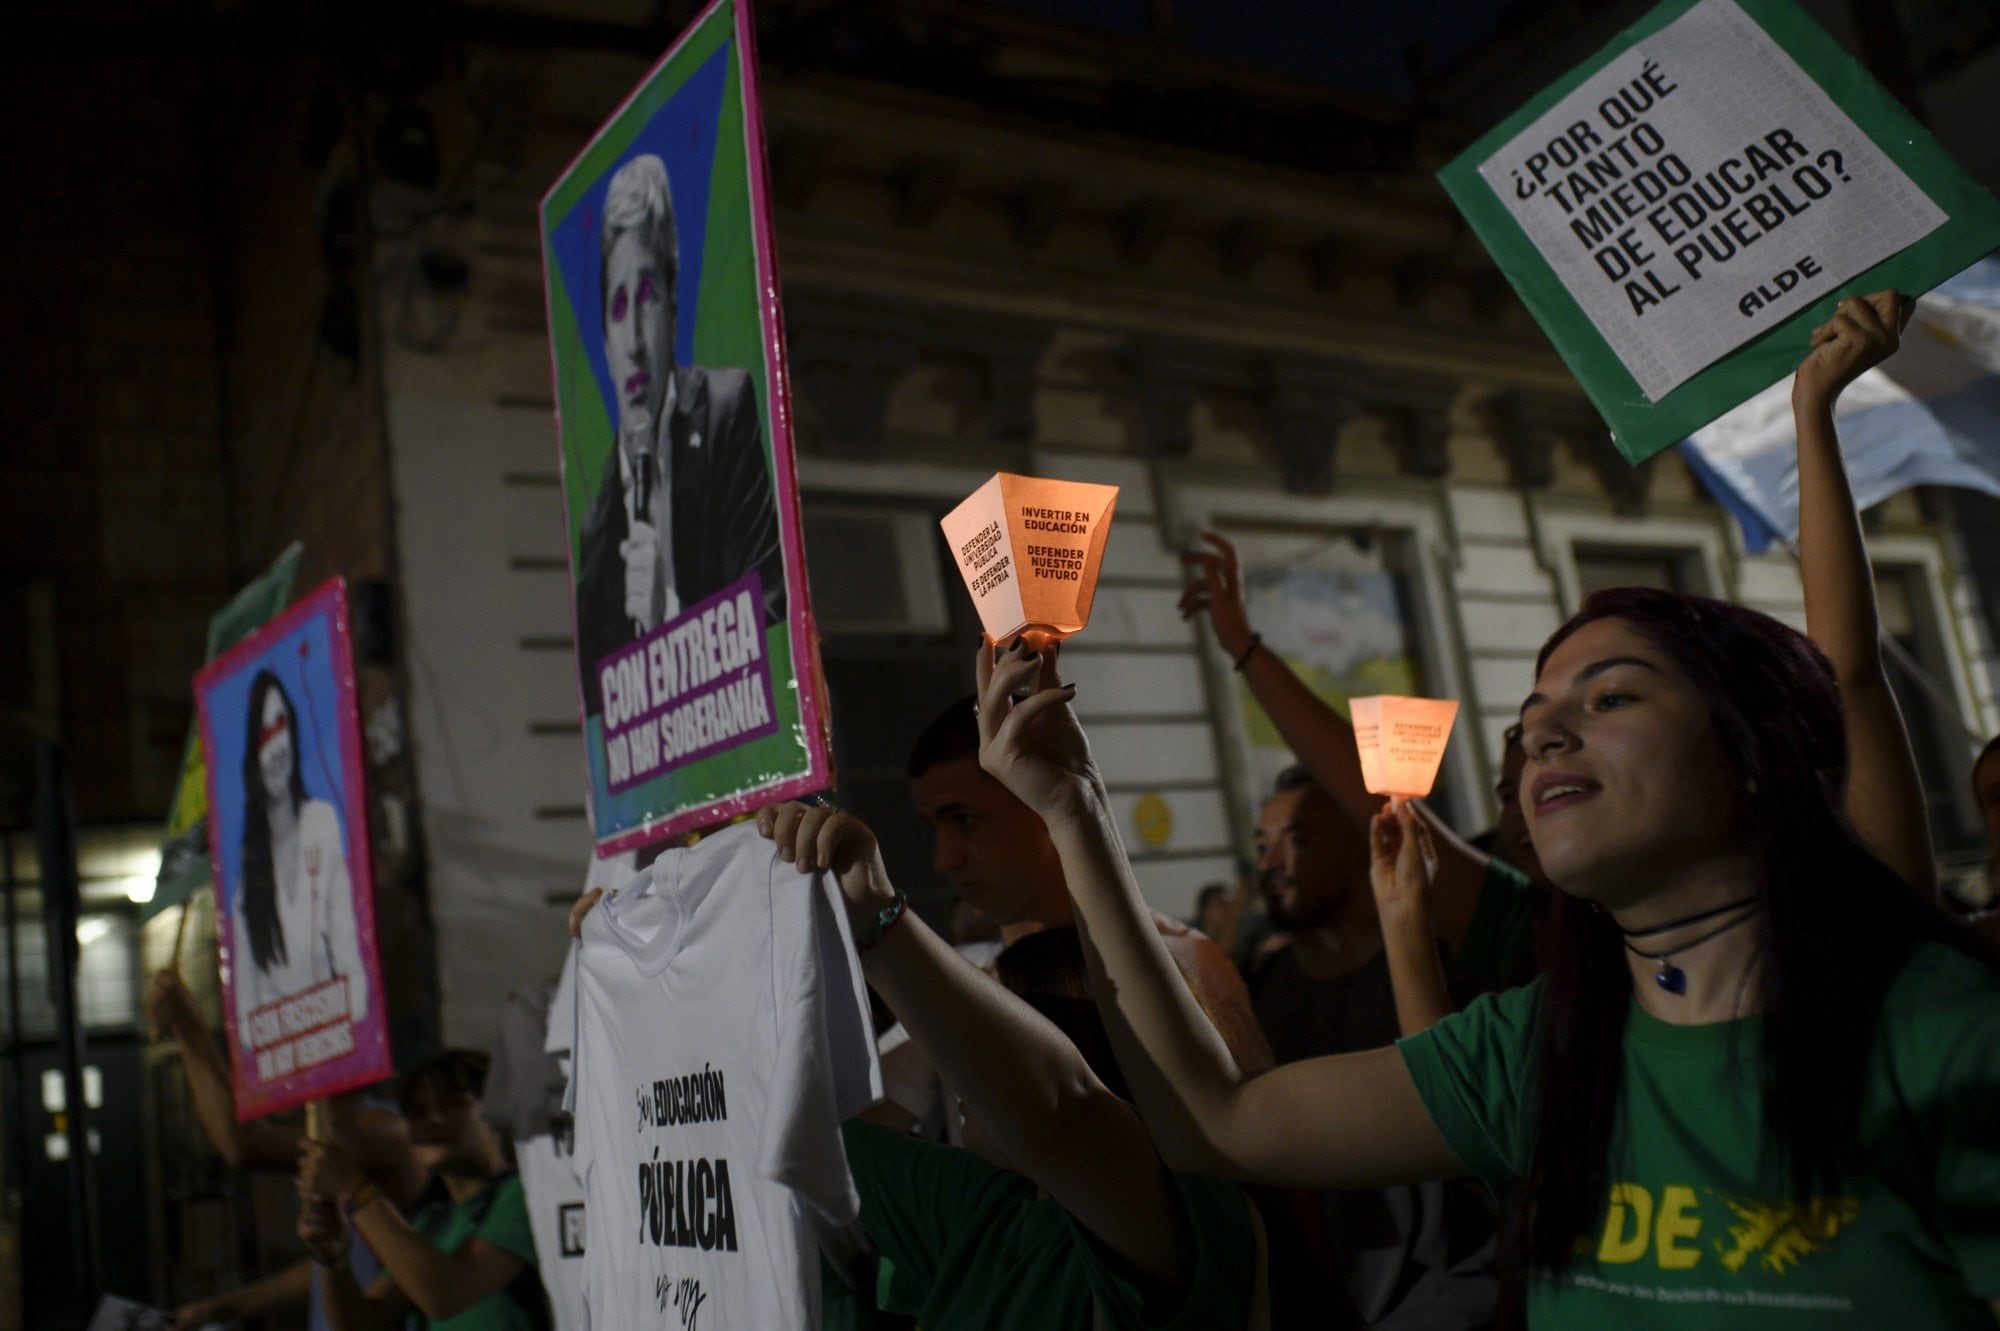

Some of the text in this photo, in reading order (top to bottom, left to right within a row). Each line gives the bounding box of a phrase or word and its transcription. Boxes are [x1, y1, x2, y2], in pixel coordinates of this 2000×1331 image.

[1511, 59, 1678, 199] ¿POR QUÉ
[1544, 122, 1665, 214] TANTO
[1570, 153, 1692, 250] MIEDO
[1594, 128, 1809, 282] DE EDUCAR
[1623, 149, 1852, 317] AL PUEBLO?
[1738, 255, 1823, 317] ALDE
[961, 520, 1000, 556] DEFENDER LA
[1022, 506, 1090, 523] INVERTIR EN
[1024, 519, 1087, 535] EDUCACIÓN
[963, 530, 1002, 566] UNIVERSIDAD
[1027, 545, 1084, 560] DEFENDER
[1031, 556, 1082, 570] NUESTRO
[971, 556, 1011, 591] ES DEFENDER
[979, 569, 1010, 598] LA PATRIA
[1034, 568, 1078, 581] FUTURO
[601, 588, 762, 731] CON ENTREGA
[606, 667, 771, 787] NO HAY SOBERANÍA
[653, 1062, 728, 1127] EDUCACIÓN
